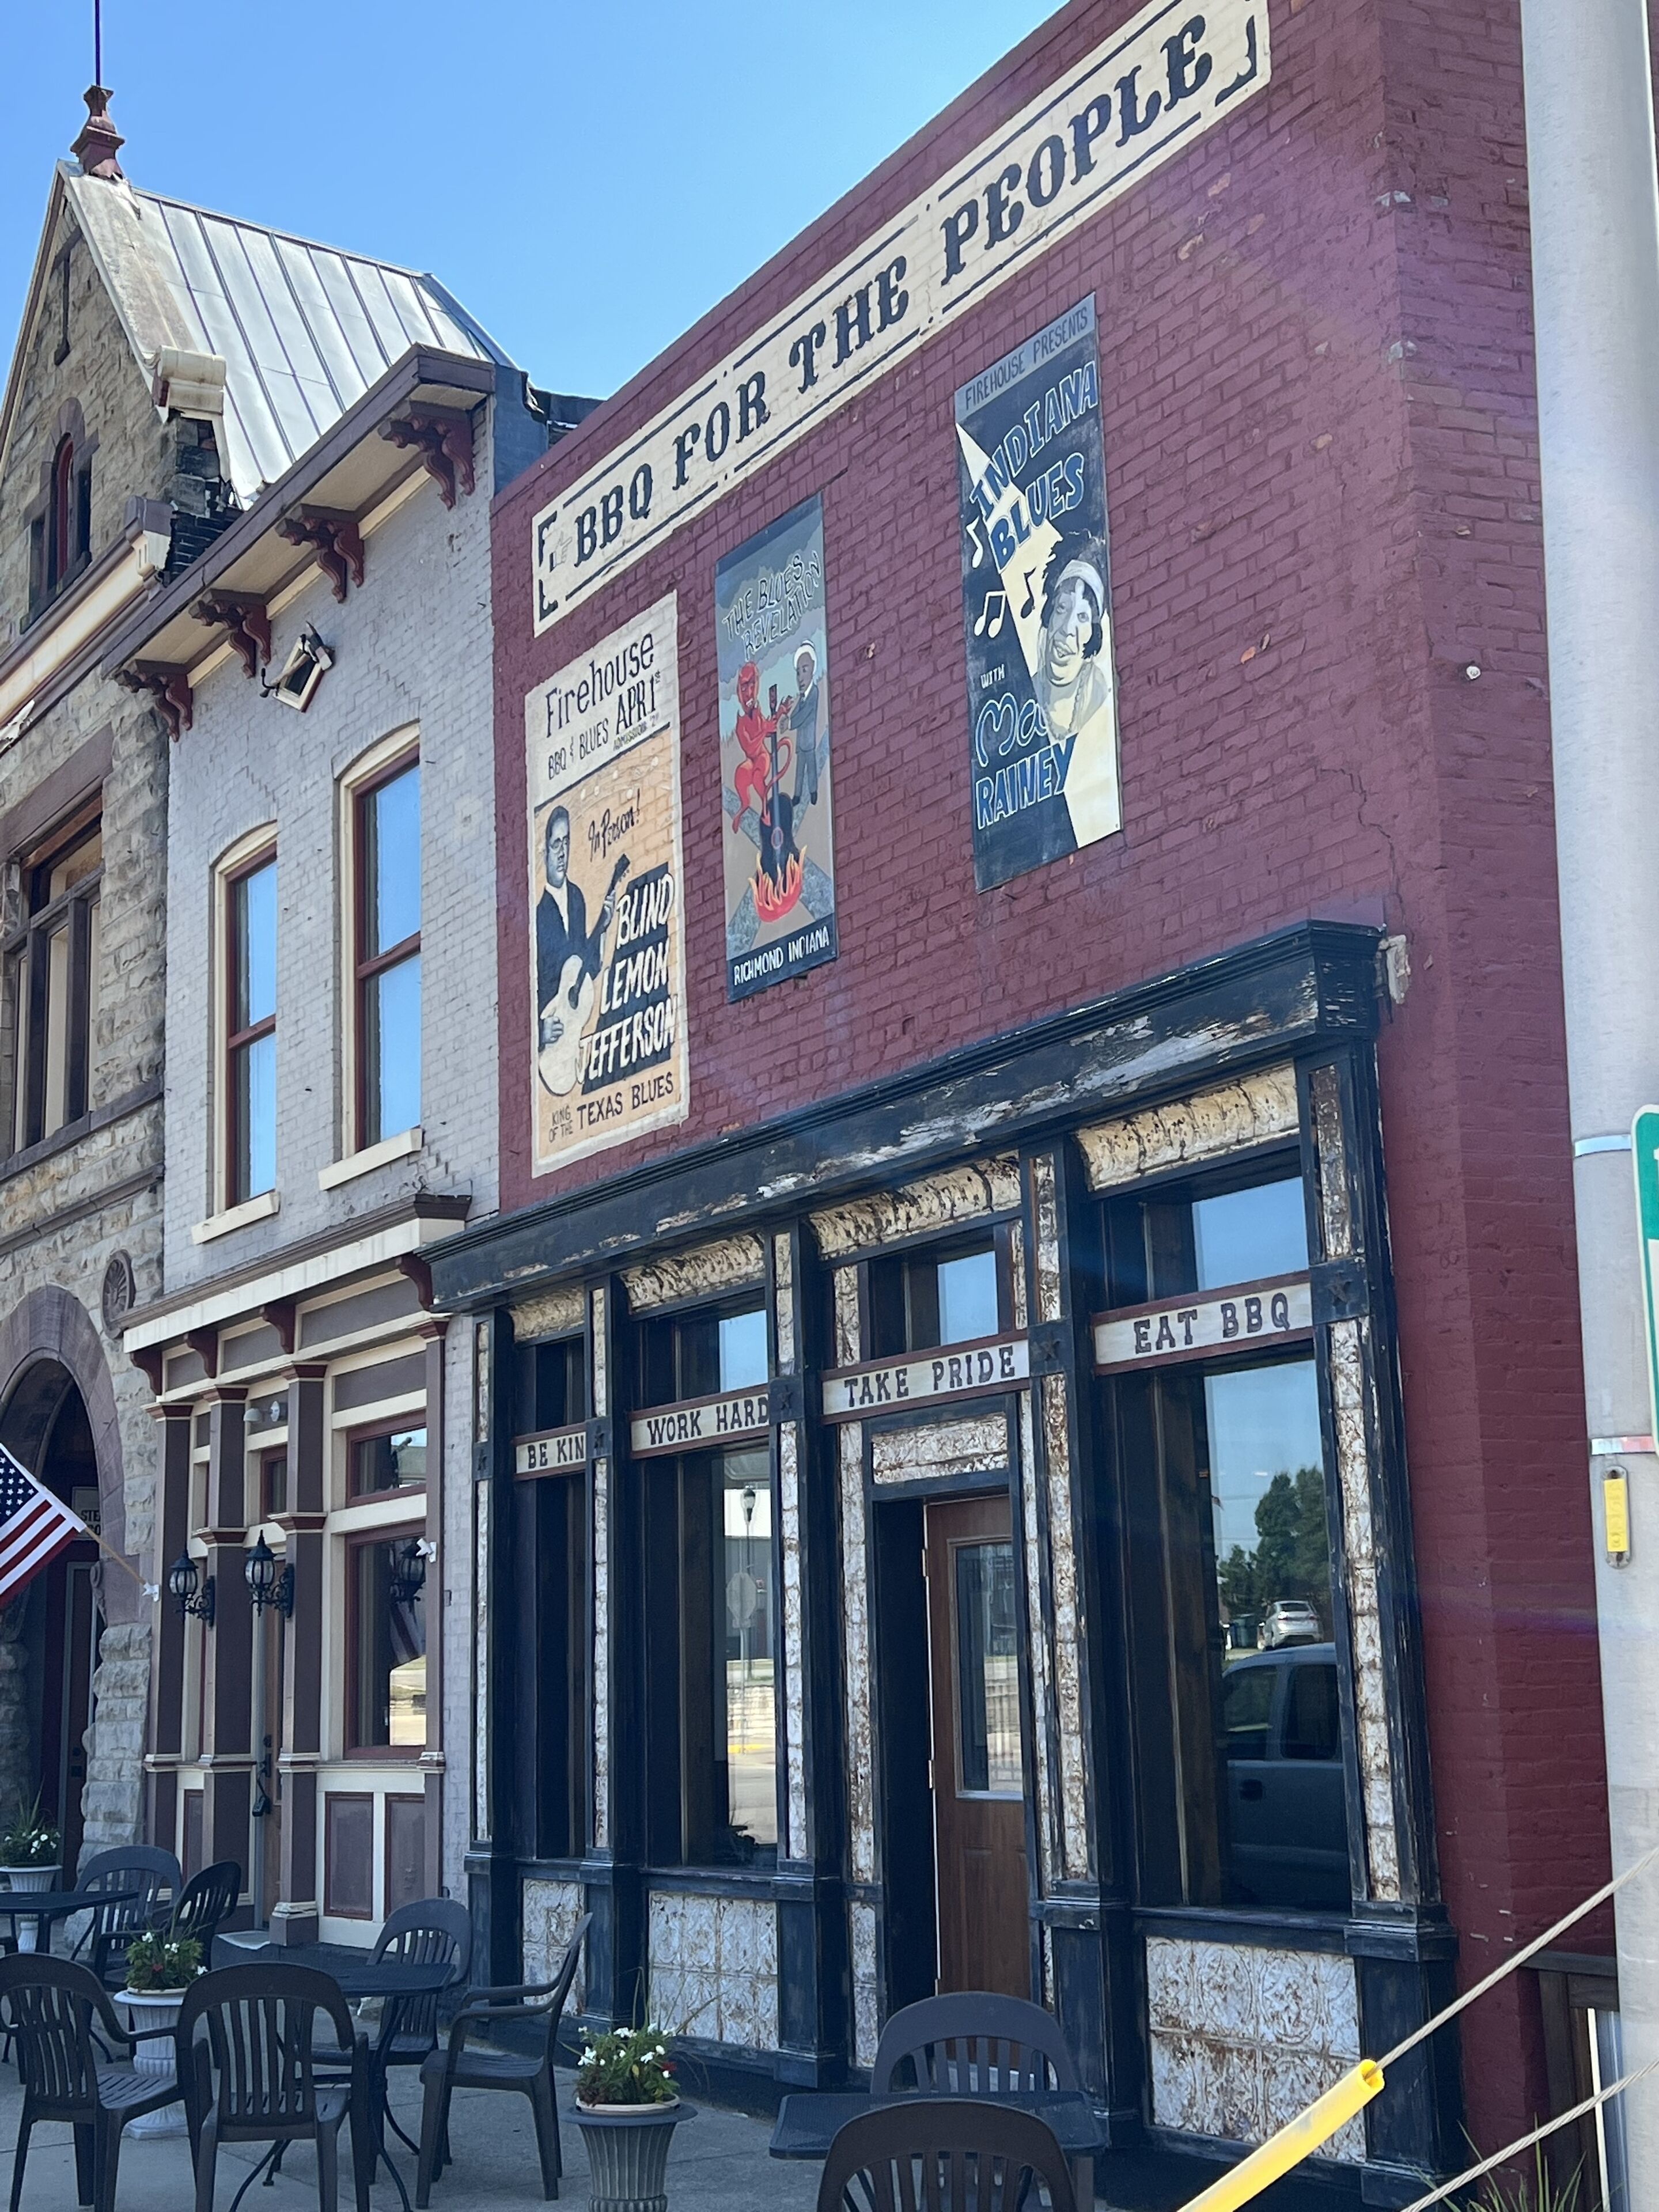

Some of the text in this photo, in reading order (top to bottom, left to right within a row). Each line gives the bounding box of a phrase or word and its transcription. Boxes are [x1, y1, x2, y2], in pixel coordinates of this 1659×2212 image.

[574, 15, 1213, 567] BBQ FOR THE PEOPLE
[965, 308, 1088, 411] FIREHOUSE PRESENTS
[969, 361, 1098, 521] INDIANA
[988, 452, 1084, 574] BLUES
[722, 553, 805, 641] THE BLUES
[741, 550, 821, 662] REVELATION
[546, 634, 654, 738] Firehouse
[616, 680, 646, 734] APR
[980, 664, 1005, 688] WITH
[548, 747, 566, 780] BBQ
[579, 718, 608, 760] BLUES
[975, 692, 1047, 767] Ma
[976, 733, 1078, 830] RAINEY
[588, 820, 600, 862] In
[616, 873, 675, 949] BLIND
[600, 937, 671, 1014] LEMON
[734, 926, 830, 986] RICHMOND INDIANA
[576, 994, 678, 1085] JEFFERSON
[549, 1119, 573, 1144] OF THE
[552, 1105, 571, 1127] KING
[577, 1072, 673, 1130] TEXAS BLUES
[1134, 1293, 1290, 1354] EAT BBQ
[844, 1346, 1015, 1407] TAKE PRIDE
[528, 1435, 584, 1469] BE KIN
[647, 1397, 769, 1445] WORK HARD
